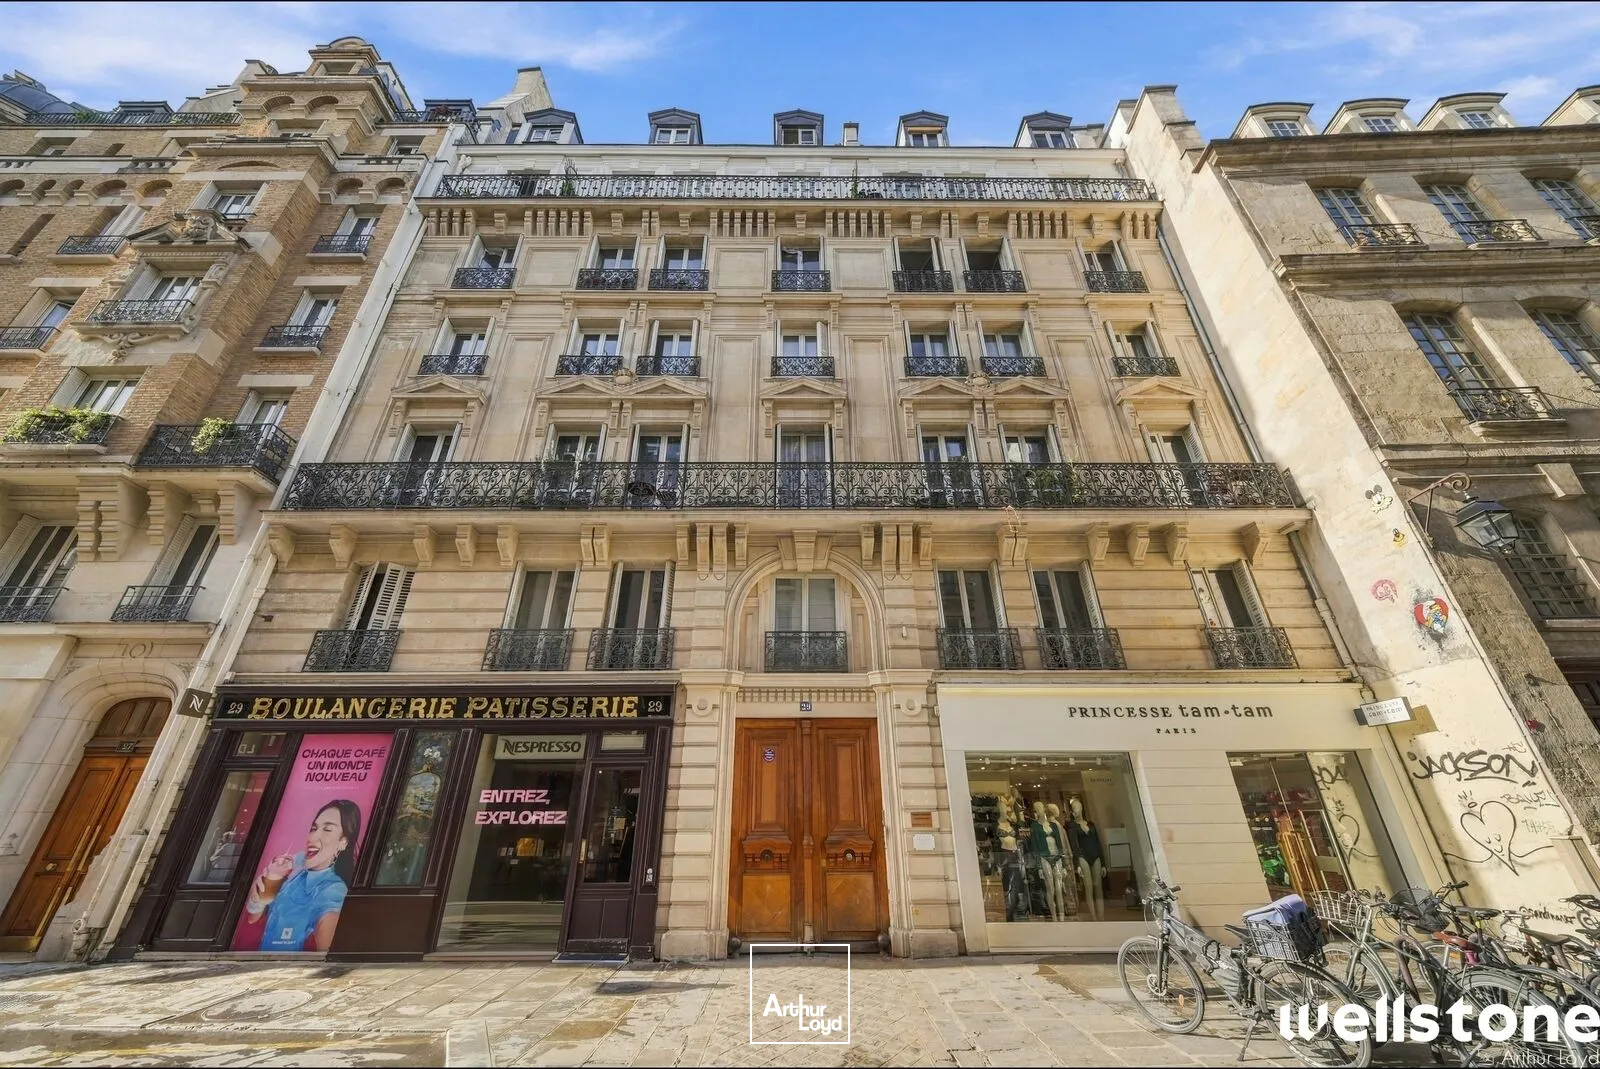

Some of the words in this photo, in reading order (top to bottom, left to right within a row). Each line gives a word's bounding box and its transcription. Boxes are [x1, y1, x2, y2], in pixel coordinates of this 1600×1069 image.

[227, 702, 244, 715] 29
[248, 697, 458, 719] BOULANGERIE
[463, 696, 639, 718] PATISSERIE
[647, 700, 663, 713] 29
[1068, 706, 1173, 718] PRINCESSE
[301, 749, 351, 759] CHAQUE
[353, 746, 387, 759] CAFÉ
[502, 738, 582, 755] NESPRESSO
[307, 761, 324, 771] UN
[326, 760, 373, 771] MONDE
[304, 772, 368, 782] NOUVEAU
[479, 789, 551, 805] ENTREZ,
[474, 810, 569, 825] EXPLOREZ
